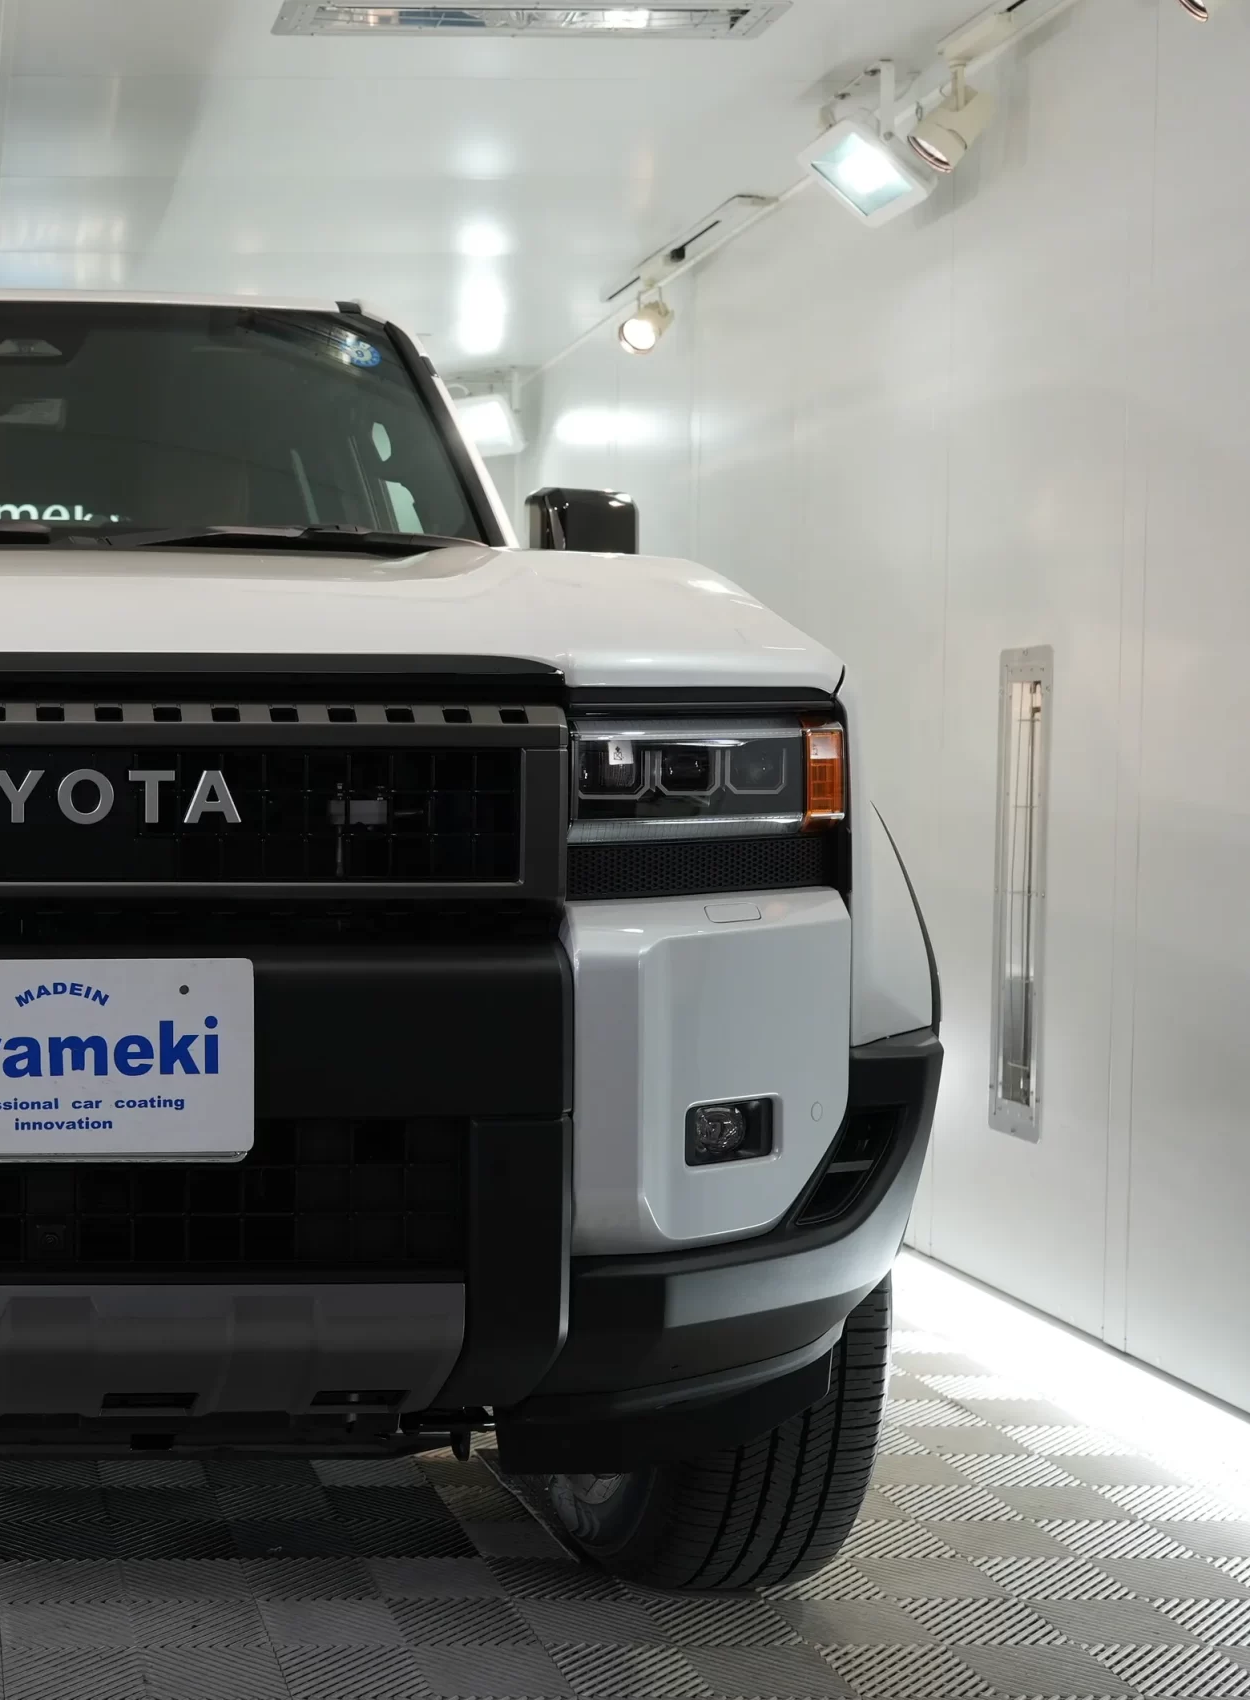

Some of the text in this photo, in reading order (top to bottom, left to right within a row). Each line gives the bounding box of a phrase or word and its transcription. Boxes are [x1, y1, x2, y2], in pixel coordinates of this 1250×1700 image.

[71, 1099, 103, 1110] car
[115, 1096, 186, 1112] coating
[14, 1118, 114, 1131] innovation
